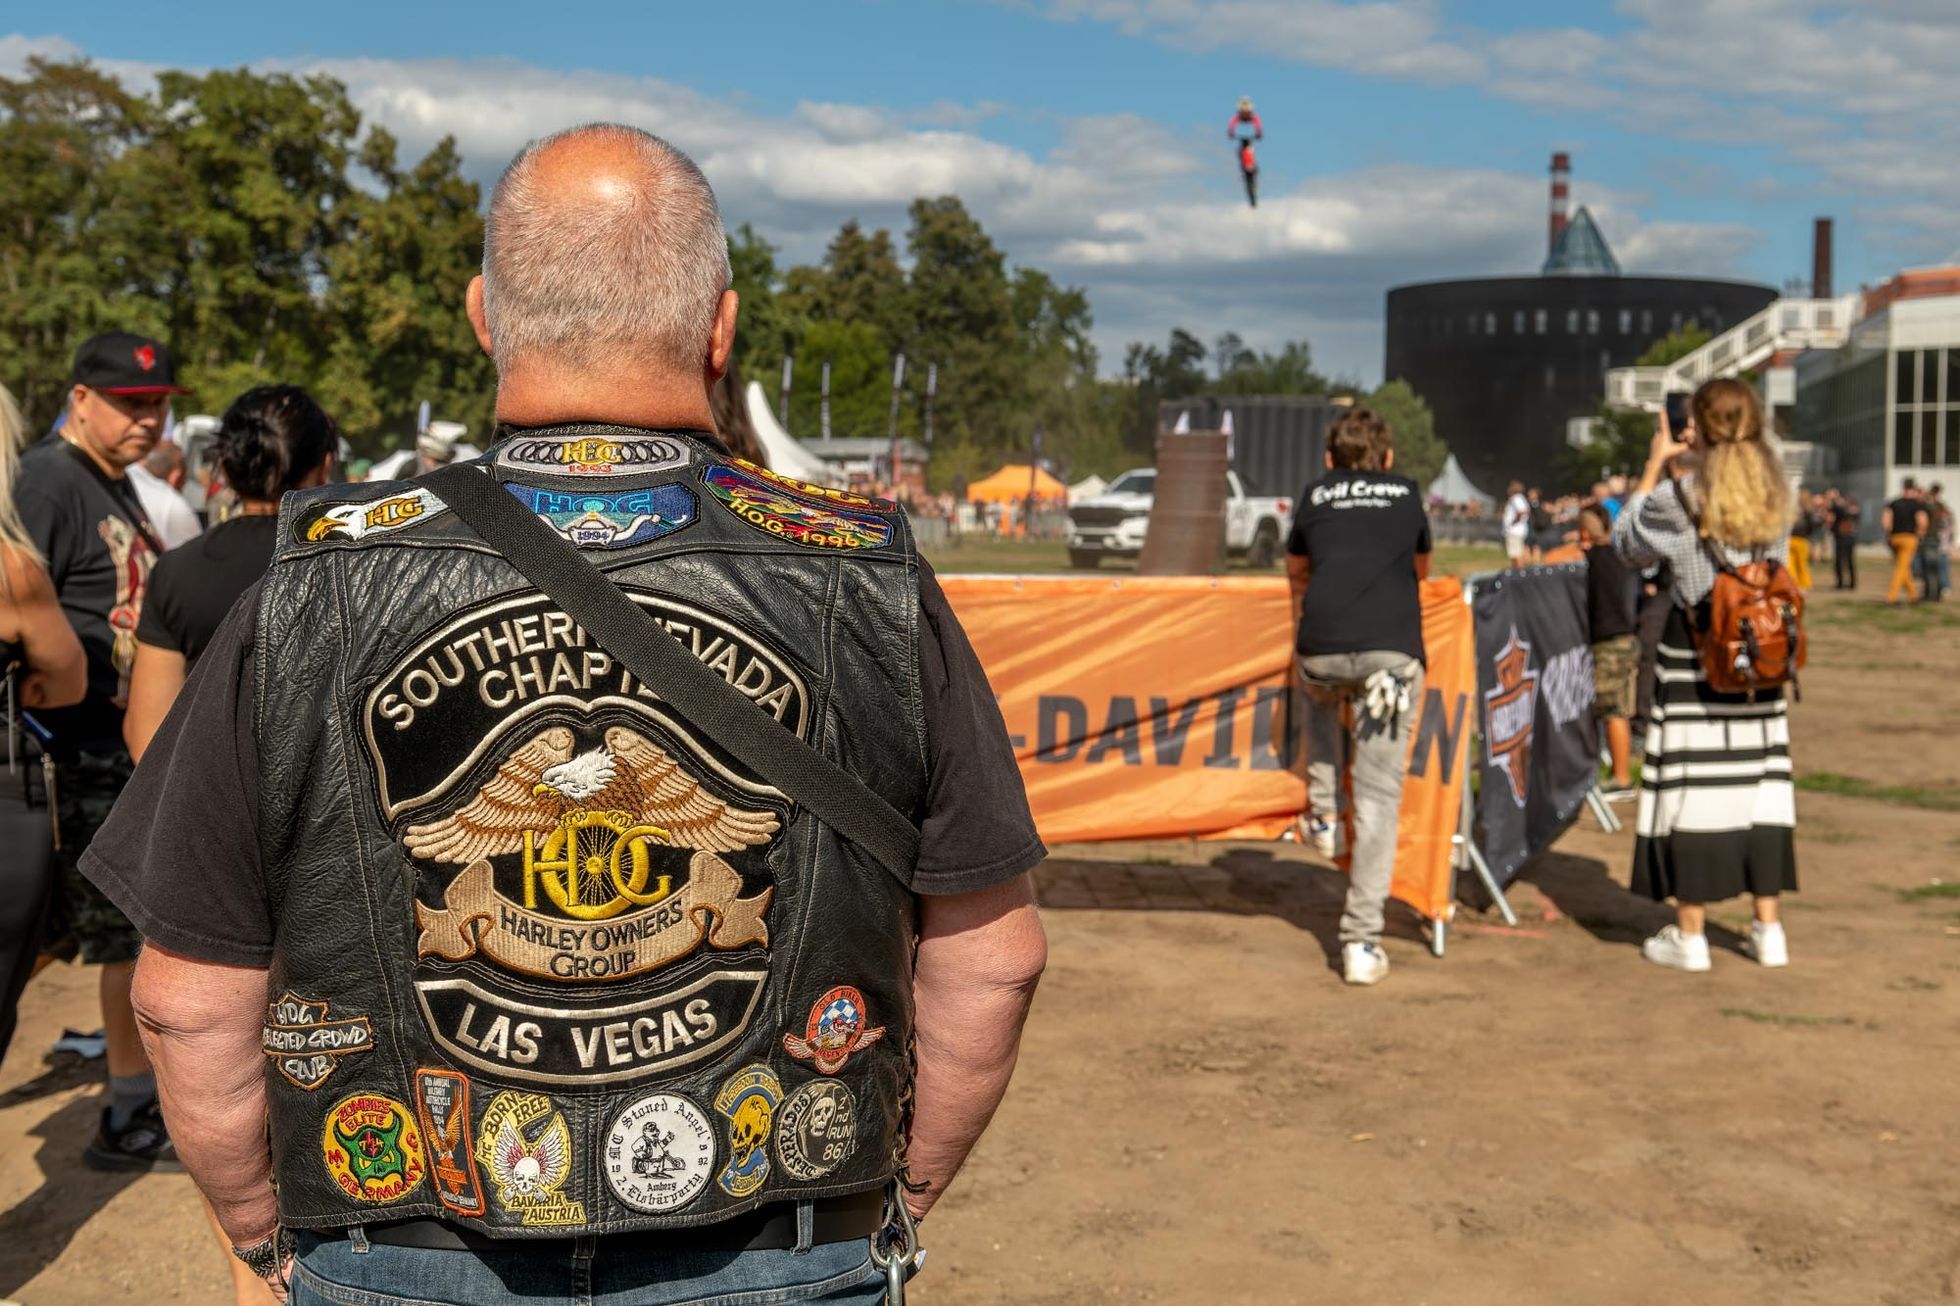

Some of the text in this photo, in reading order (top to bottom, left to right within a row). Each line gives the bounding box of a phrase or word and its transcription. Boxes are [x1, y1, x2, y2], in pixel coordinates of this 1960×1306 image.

[535, 491, 652, 513] HOG
[577, 531, 610, 541] 1994
[801, 531, 861, 548] 1996
[655, 617, 795, 723] VADA
[1010, 686, 1468, 785] -DAVIN
[500, 901, 684, 951] HARLEY OWNERS
[550, 951, 636, 978] GROUP
[308, 1026, 368, 1048] CROWD
[455, 998, 718, 1069] LAS VEGAS
[285, 1055, 331, 1080] CLUB
[345, 1112, 386, 1131] ELITE
[485, 1093, 549, 1139] BORN FREE
[828, 1126, 851, 1140] RUN
[698, 1157, 709, 1166] 92
[823, 1142, 842, 1161] 86
[338, 1157, 423, 1200] GERMANY
[647, 1182, 677, 1192] Amberg
[511, 1193, 564, 1207] BAVARIA
